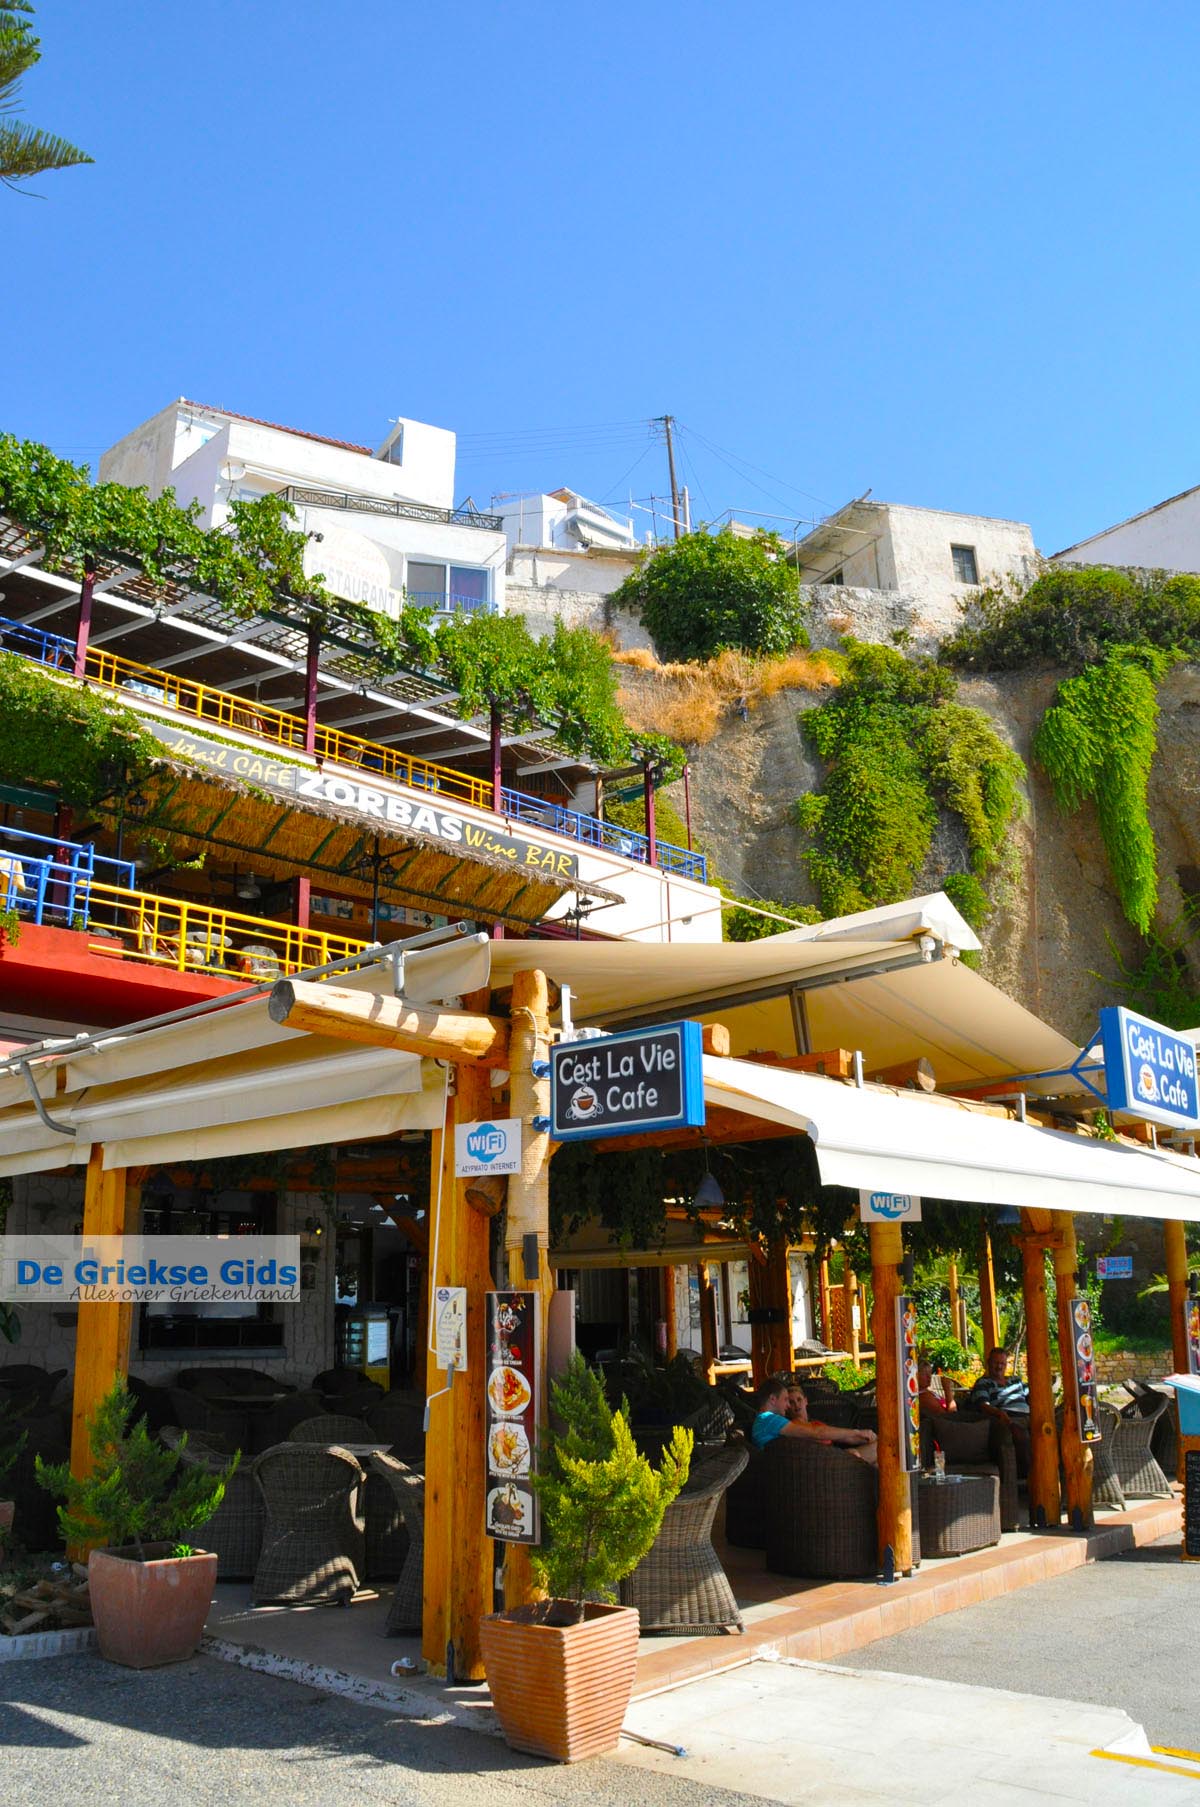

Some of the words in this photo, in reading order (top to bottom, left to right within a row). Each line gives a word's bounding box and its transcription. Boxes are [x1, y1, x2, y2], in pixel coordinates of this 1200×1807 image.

[297, 774, 462, 841] ZORBAS
[465, 824, 517, 860] Wine
[526, 845, 573, 876] BAR
[559, 1055, 601, 1086] C'est
[607, 1051, 634, 1079] La
[640, 1043, 676, 1073] Vie
[1128, 1024, 1156, 1064] C'est
[1157, 1037, 1175, 1070] La
[1174, 1043, 1194, 1079] Vie
[606, 1081, 659, 1112] Cafe
[1161, 1075, 1189, 1110] Cafe
[490, 1161, 517, 1171] INTERNET
